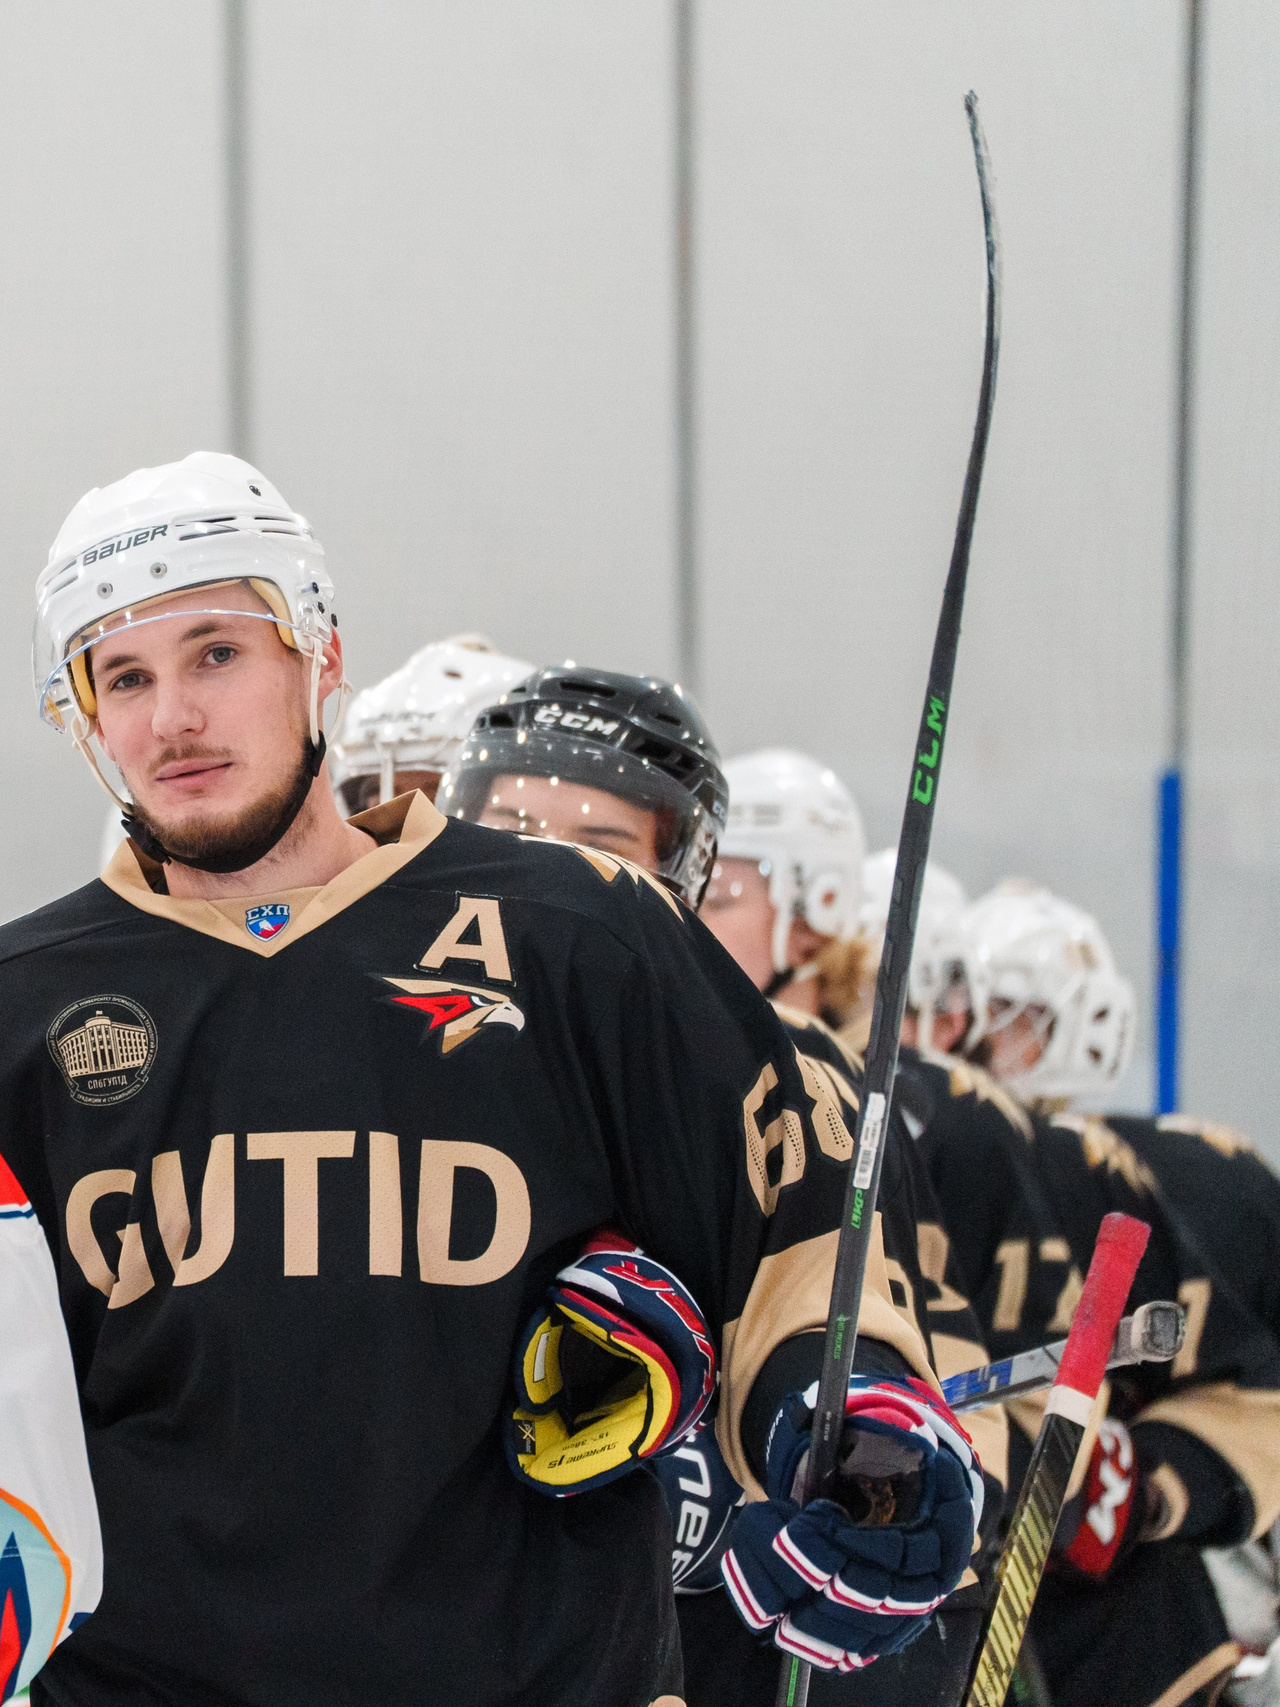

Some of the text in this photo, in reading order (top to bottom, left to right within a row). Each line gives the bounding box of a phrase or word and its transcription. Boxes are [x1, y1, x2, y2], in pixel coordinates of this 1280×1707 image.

[534, 705, 620, 735] CCM
[417, 894, 516, 984] A
[66, 1130, 532, 1310] GUTID
